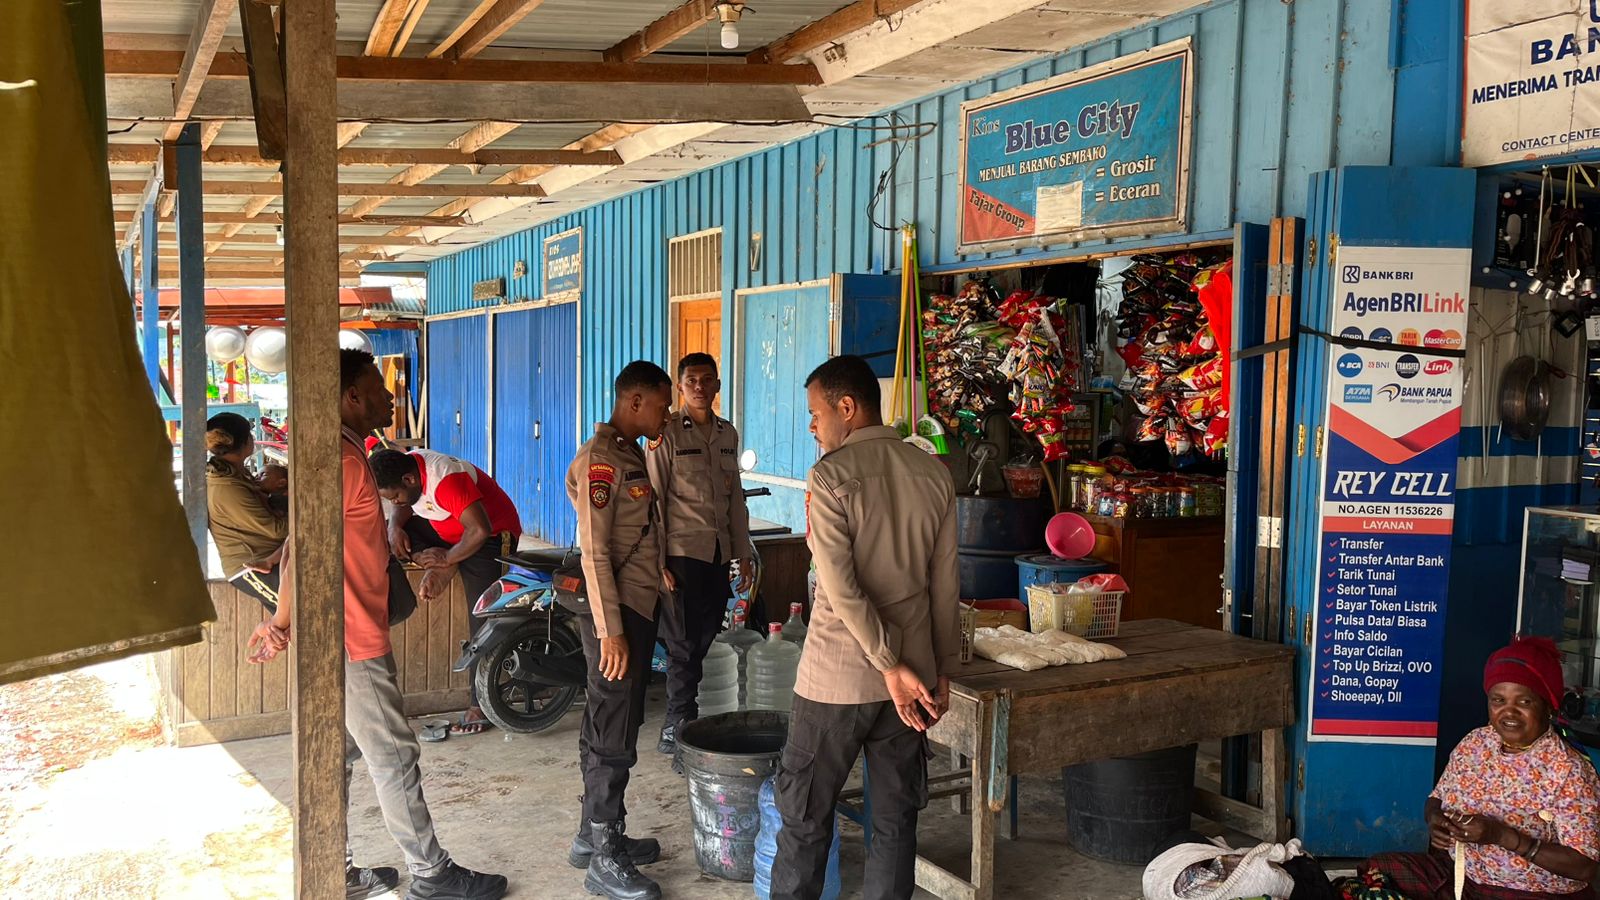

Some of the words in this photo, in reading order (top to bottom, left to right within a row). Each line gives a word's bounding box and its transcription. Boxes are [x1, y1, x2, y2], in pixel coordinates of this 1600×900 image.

[1472, 74, 1558, 104] MENERIMA
[971, 115, 1000, 137] Kios
[1005, 119, 1070, 155] Blue
[1076, 99, 1140, 140] City
[1502, 135, 1556, 152] CONTACT
[978, 160, 1017, 182] MENJUAL
[1019, 155, 1057, 175] BARANG
[1059, 145, 1107, 167] SEMBAKO
[1110, 154, 1156, 177] Grosir
[1109, 182, 1161, 203] Eceran
[969, 190, 995, 214] Fajar
[995, 203, 1025, 231] Group
[1343, 292, 1465, 317] AgenBRILink
[1424, 336, 1461, 345] MasterCard
[1376, 361, 1389, 369] BNI
[1396, 361, 1420, 371] TRANSFER
[1425, 361, 1451, 372] Link
[1345, 386, 1371, 395] ATM
[1401, 387, 1424, 397] BANK
[1426, 388, 1452, 398] PAPUA
[1332, 470, 1387, 499] REY
[1390, 471, 1452, 497] CELL
[1338, 504, 1390, 515] NO.AGEN
[1394, 506, 1443, 516] 11536226
[1362, 520, 1413, 530] LAYANAN
[1339, 538, 1384, 550] Transfer
[1339, 553, 1383, 565] Transfer
[1384, 554, 1414, 566] Antar
[1417, 555, 1444, 566] Bank
[1338, 568, 1364, 580] Tarik
[1367, 569, 1395, 581] Tunai
[1336, 583, 1365, 596] Setor
[1369, 584, 1397, 596] Tunai
[1336, 599, 1367, 613] Bayar
[1370, 600, 1401, 612] Token
[1404, 601, 1437, 612] Listrik
[1335, 614, 1364, 626] Pulsa
[1368, 615, 1395, 627] Data/
[1397, 616, 1427, 627] Biasa
[1334, 629, 1355, 641] Info
[1357, 630, 1387, 641] Saldo
[1333, 645, 1364, 658] Bayar
[1367, 645, 1403, 657] Cicilan
[1333, 660, 1352, 673] Top
[1355, 660, 1370, 673] Up
[1372, 661, 1405, 674] Brizzi,
[1407, 662, 1432, 673] OVO
[1332, 675, 1362, 688] Dana,
[1364, 676, 1399, 689] Gopay
[1331, 690, 1385, 704] Shoeepay,
